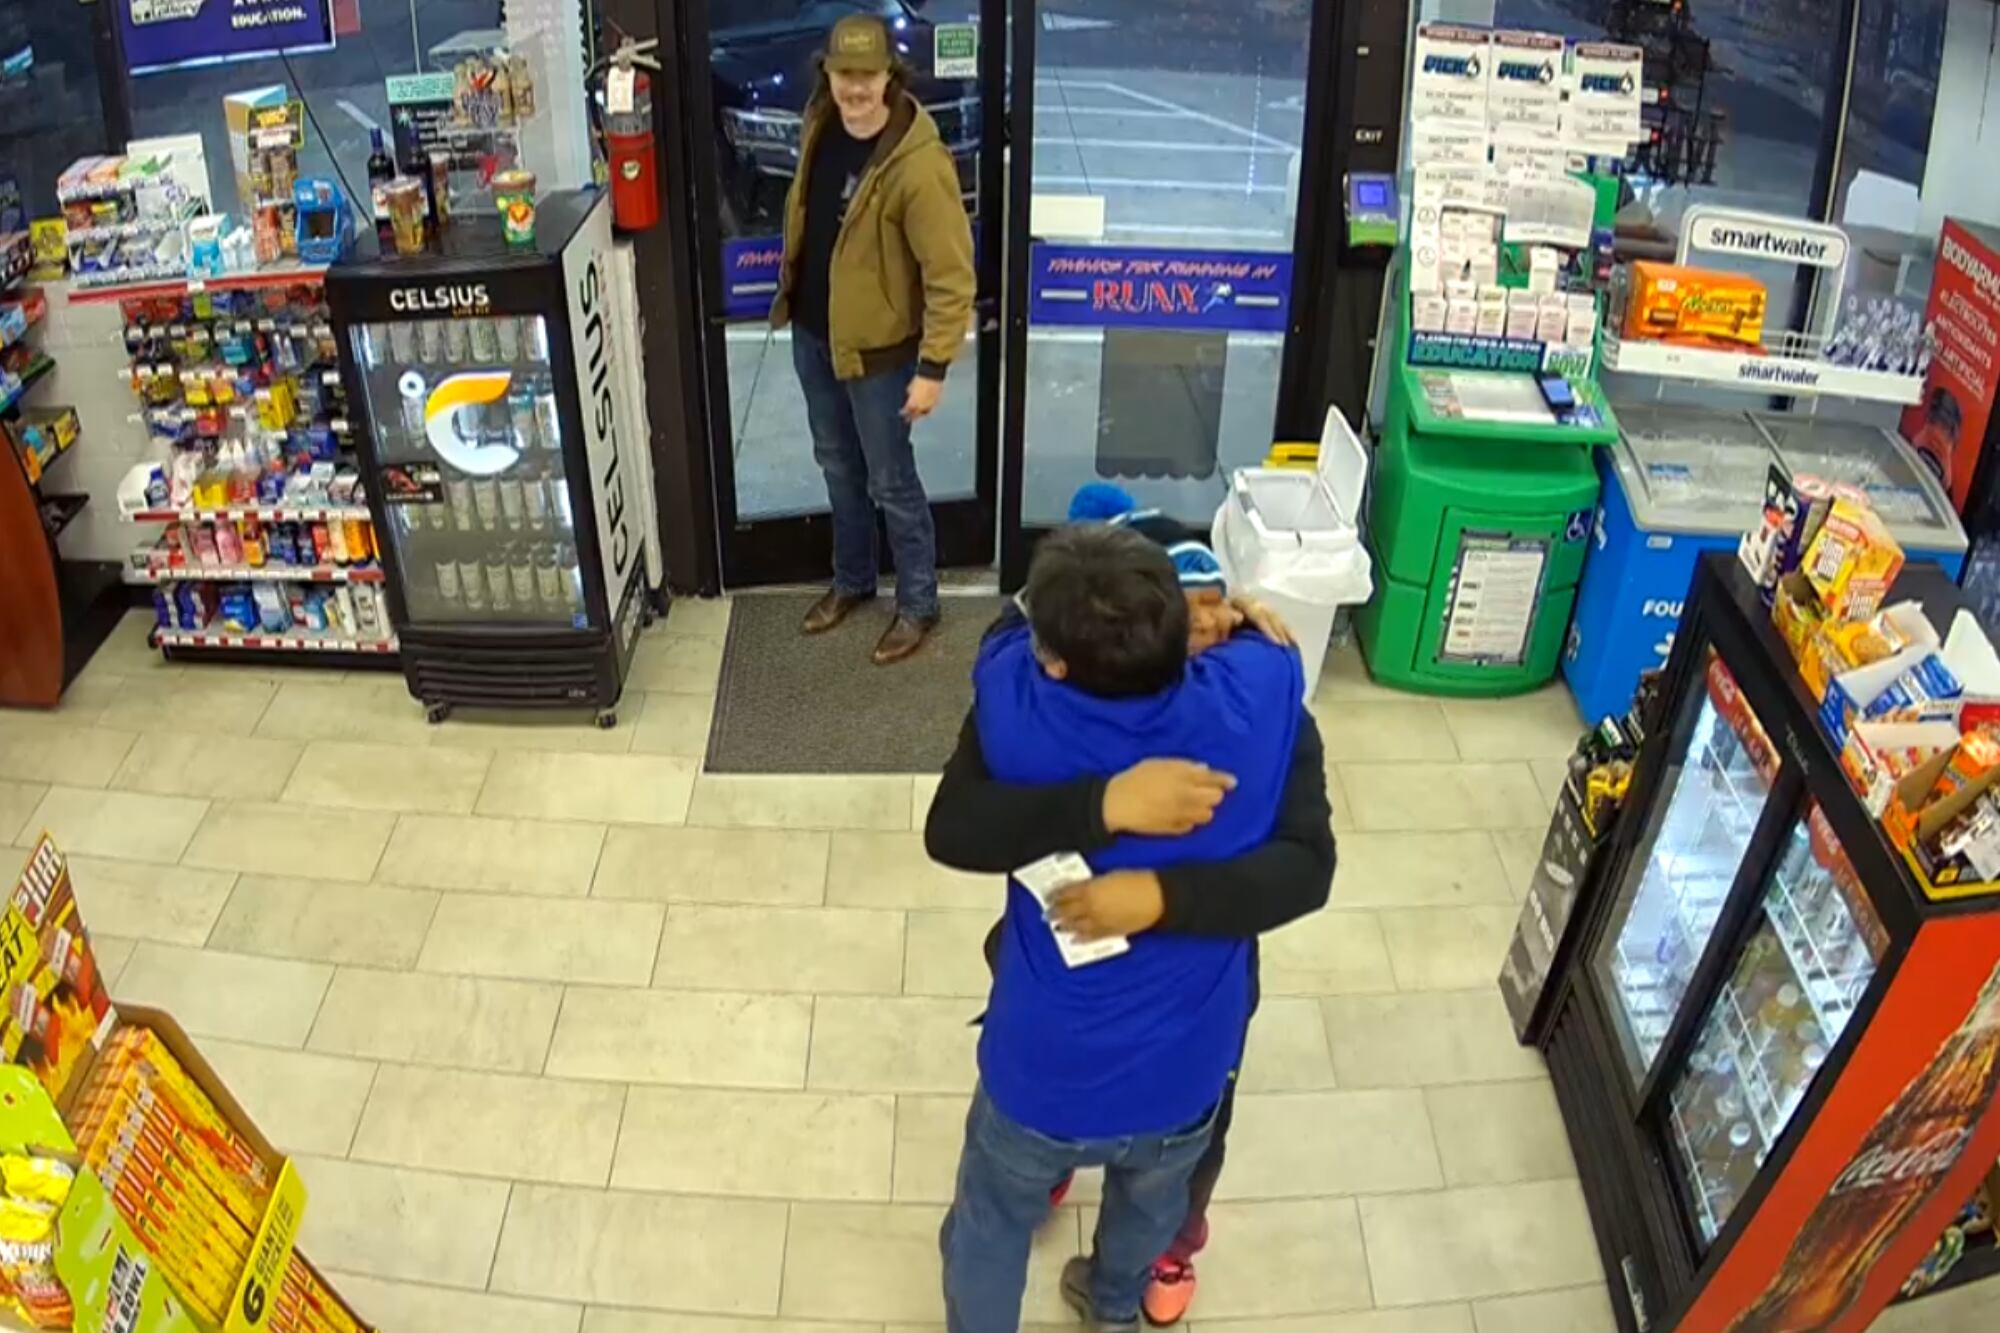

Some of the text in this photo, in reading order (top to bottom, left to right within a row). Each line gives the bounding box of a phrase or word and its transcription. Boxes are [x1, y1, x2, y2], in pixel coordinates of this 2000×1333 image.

[231, 9, 307, 28] EDUCATION.
[1355, 128, 1383, 143] EXIT
[1711, 226, 1827, 260] smartwater
[1165, 261, 1250, 278] RUNNING
[1251, 264, 1278, 280] IN
[389, 284, 489, 312] CELSIUS
[1738, 360, 1820, 387] smartwater
[580, 259, 628, 577] CELSIUS
[244, 1275, 266, 1326] 6
